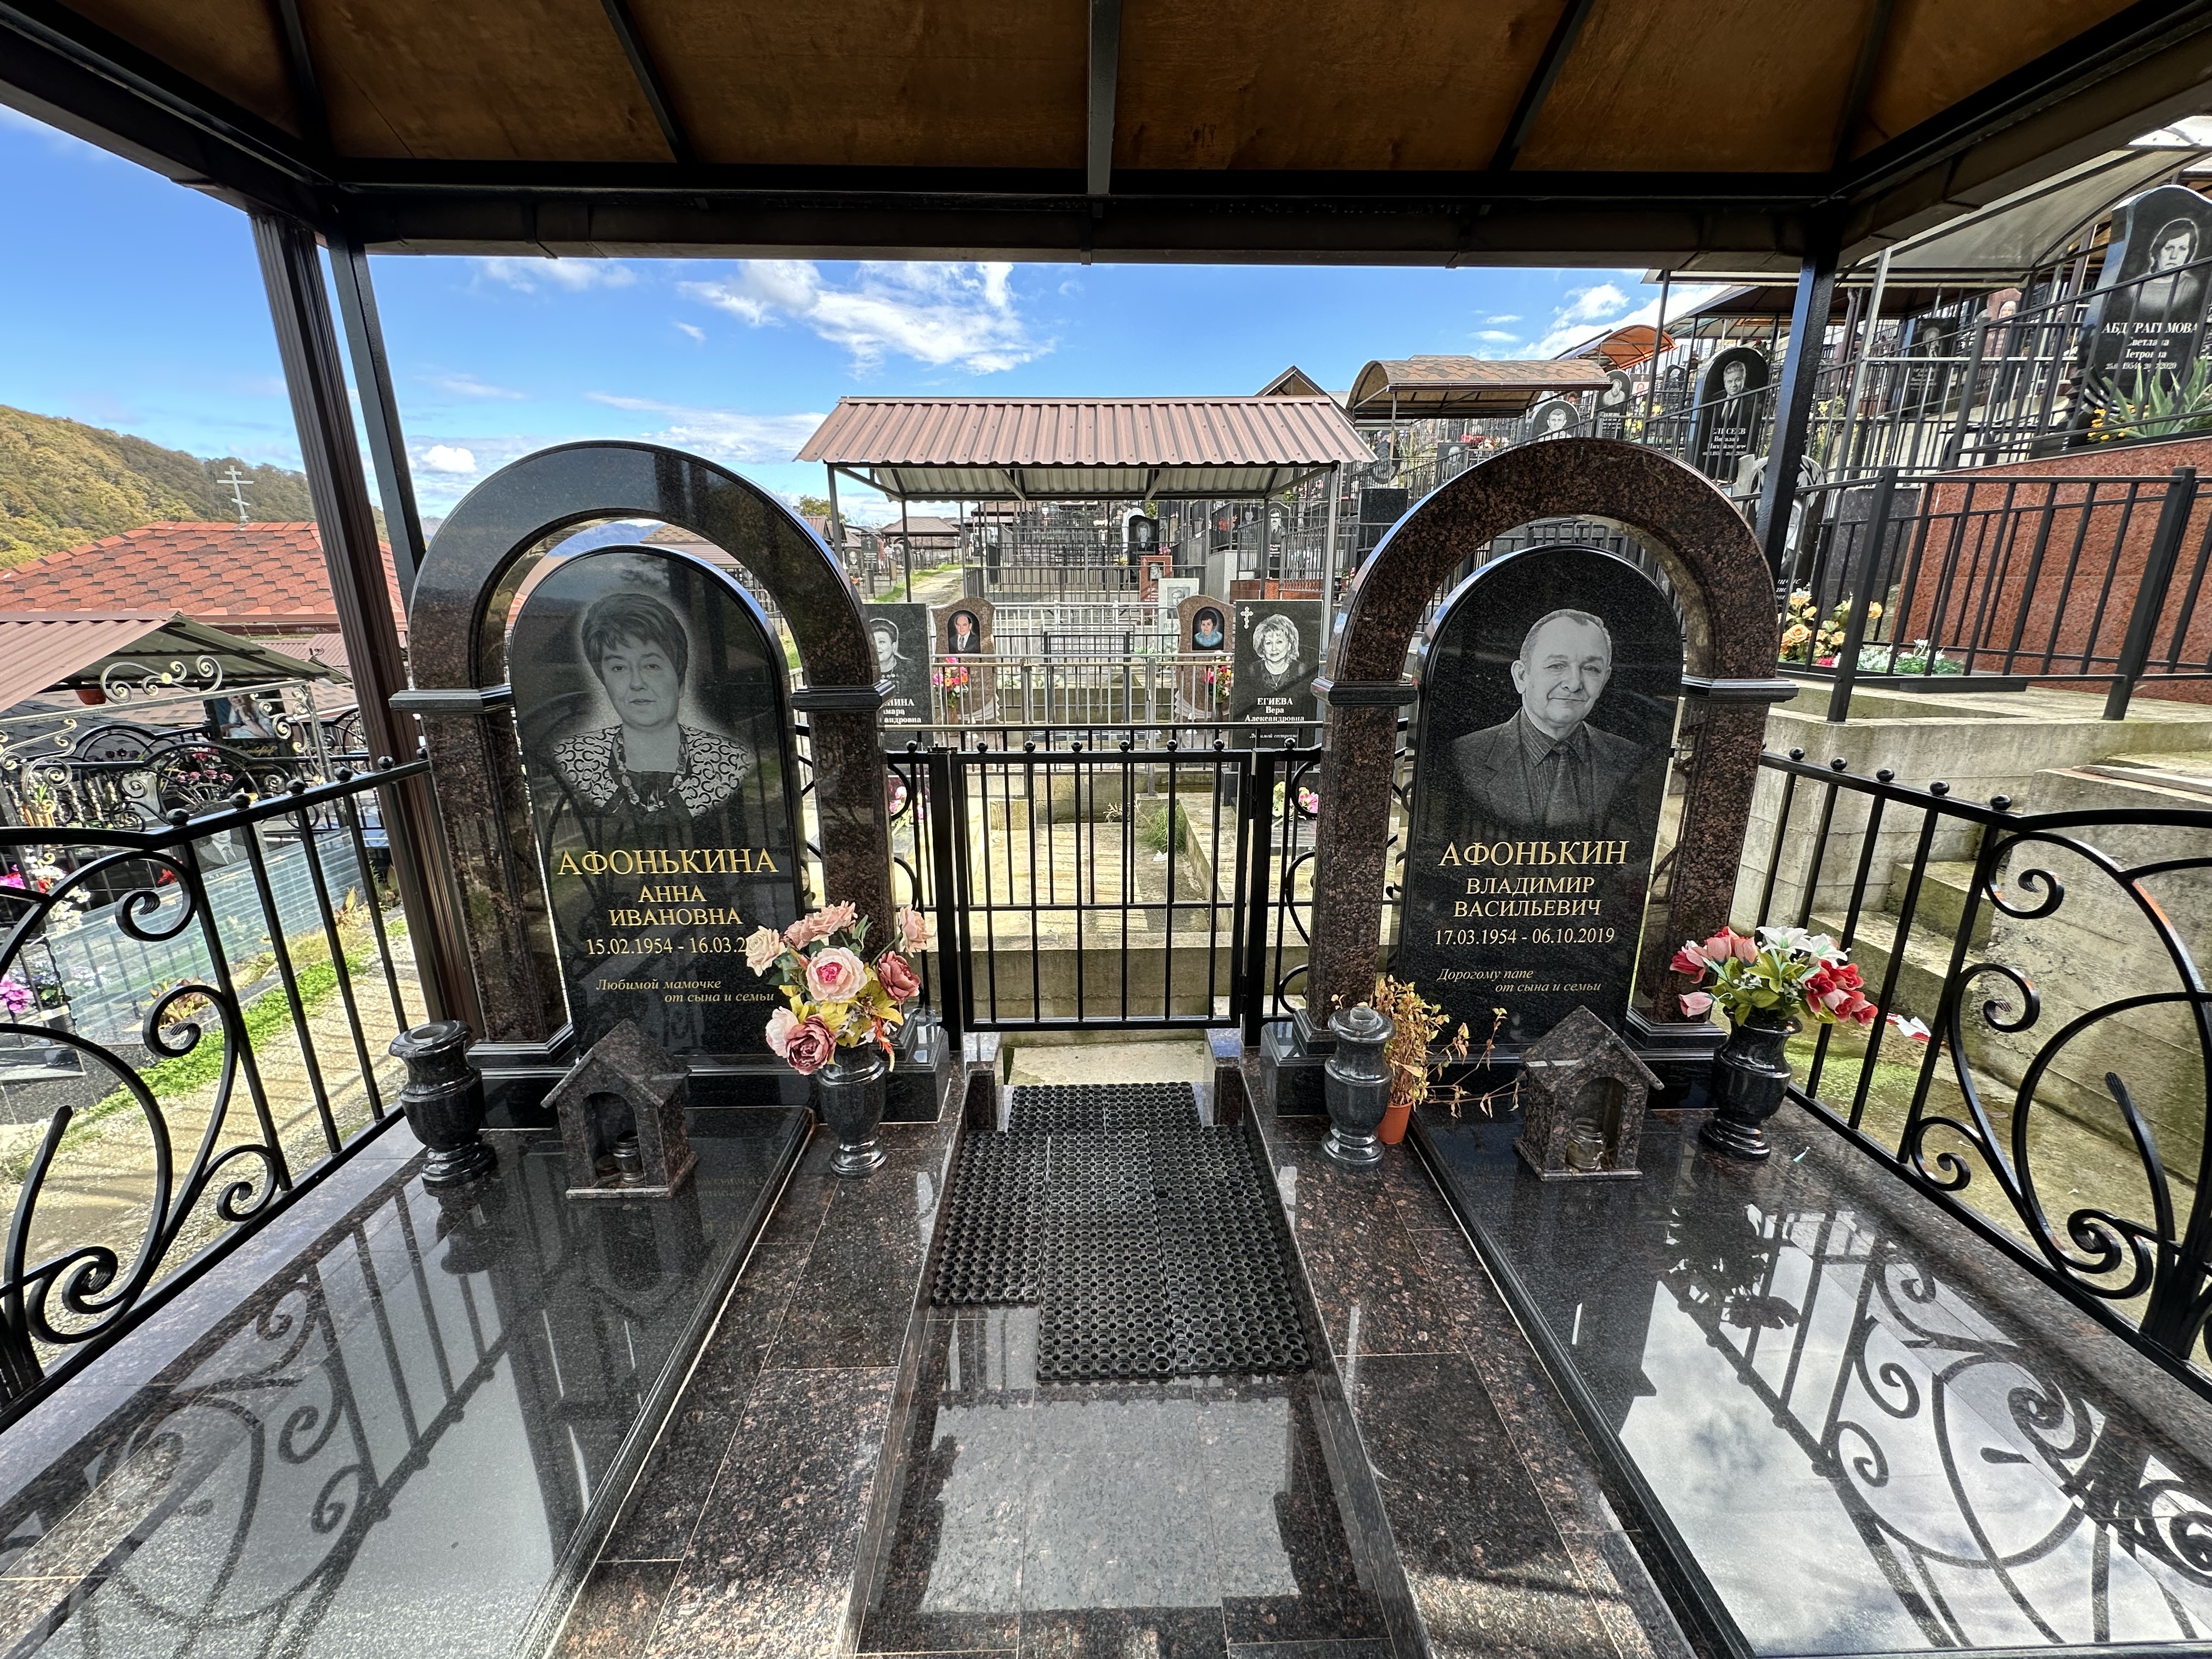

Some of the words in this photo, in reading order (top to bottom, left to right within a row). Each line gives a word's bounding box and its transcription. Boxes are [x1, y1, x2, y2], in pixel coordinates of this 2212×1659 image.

[1266, 706, 1284, 715] Вера
[557, 847, 779, 875] АФОНЬКИНА
[1437, 840, 1629, 866] АФОНЬКИН
[637, 884, 707, 903] АННА
[1465, 876, 1595, 897] ВЛАДИМИР
[608, 907, 743, 926] ИВАНОВНА
[1453, 899, 1602, 917] ВАСИЛЬЕВИЧ
[1435, 929, 1517, 945] 17.03.1954
[1532, 927, 1615, 944] 06.10.2019
[586, 937, 673, 955] 15.02.1954
[690, 936, 747, 954] 16.03.2
[1436, 968, 1501, 982] Дорогому
[1503, 970, 1533, 979] папе
[596, 979, 659, 990] Любимой
[663, 980, 721, 989] мамочке
[1495, 984, 1514, 992] от
[1517, 983, 1549, 992] сына
[1553, 983, 1560, 991] и
[1563, 983, 1601, 991] семьи
[664, 994, 683, 1003] от
[687, 994, 720, 1002] сына
[724, 994, 732, 1002] и
[736, 993, 774, 1002] семьи
